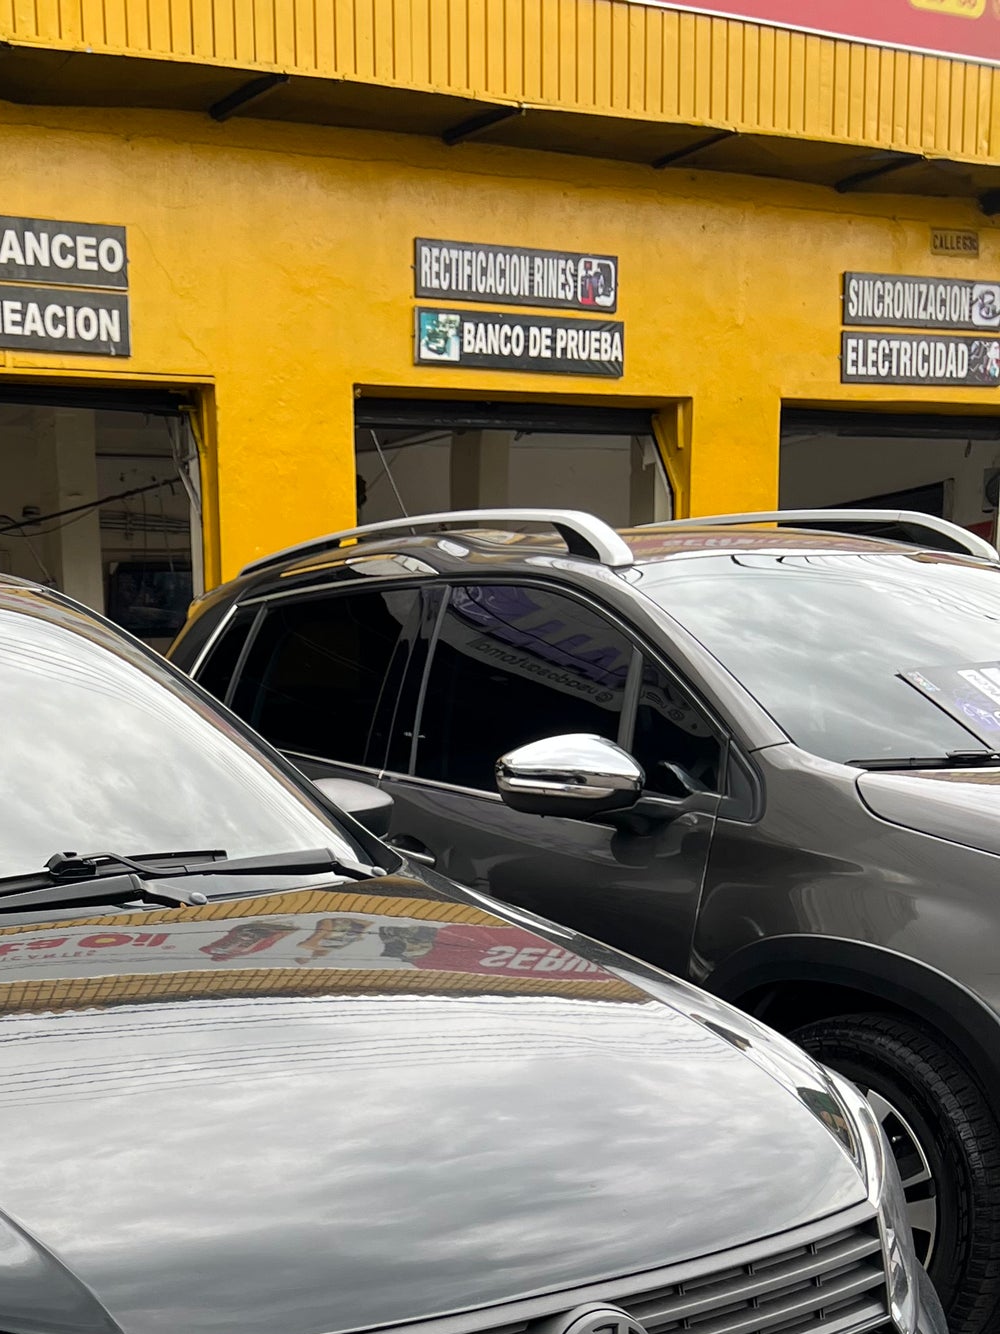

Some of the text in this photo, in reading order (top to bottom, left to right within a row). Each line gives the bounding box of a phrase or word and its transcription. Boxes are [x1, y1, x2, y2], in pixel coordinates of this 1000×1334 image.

[420, 246, 575, 301] RECTIFICACION RINES
[848, 278, 971, 323] SINCRONIZACION
[463, 321, 623, 362] BANCO DE PRUEBA
[846, 338, 969, 379] ELECTRICIDAD
